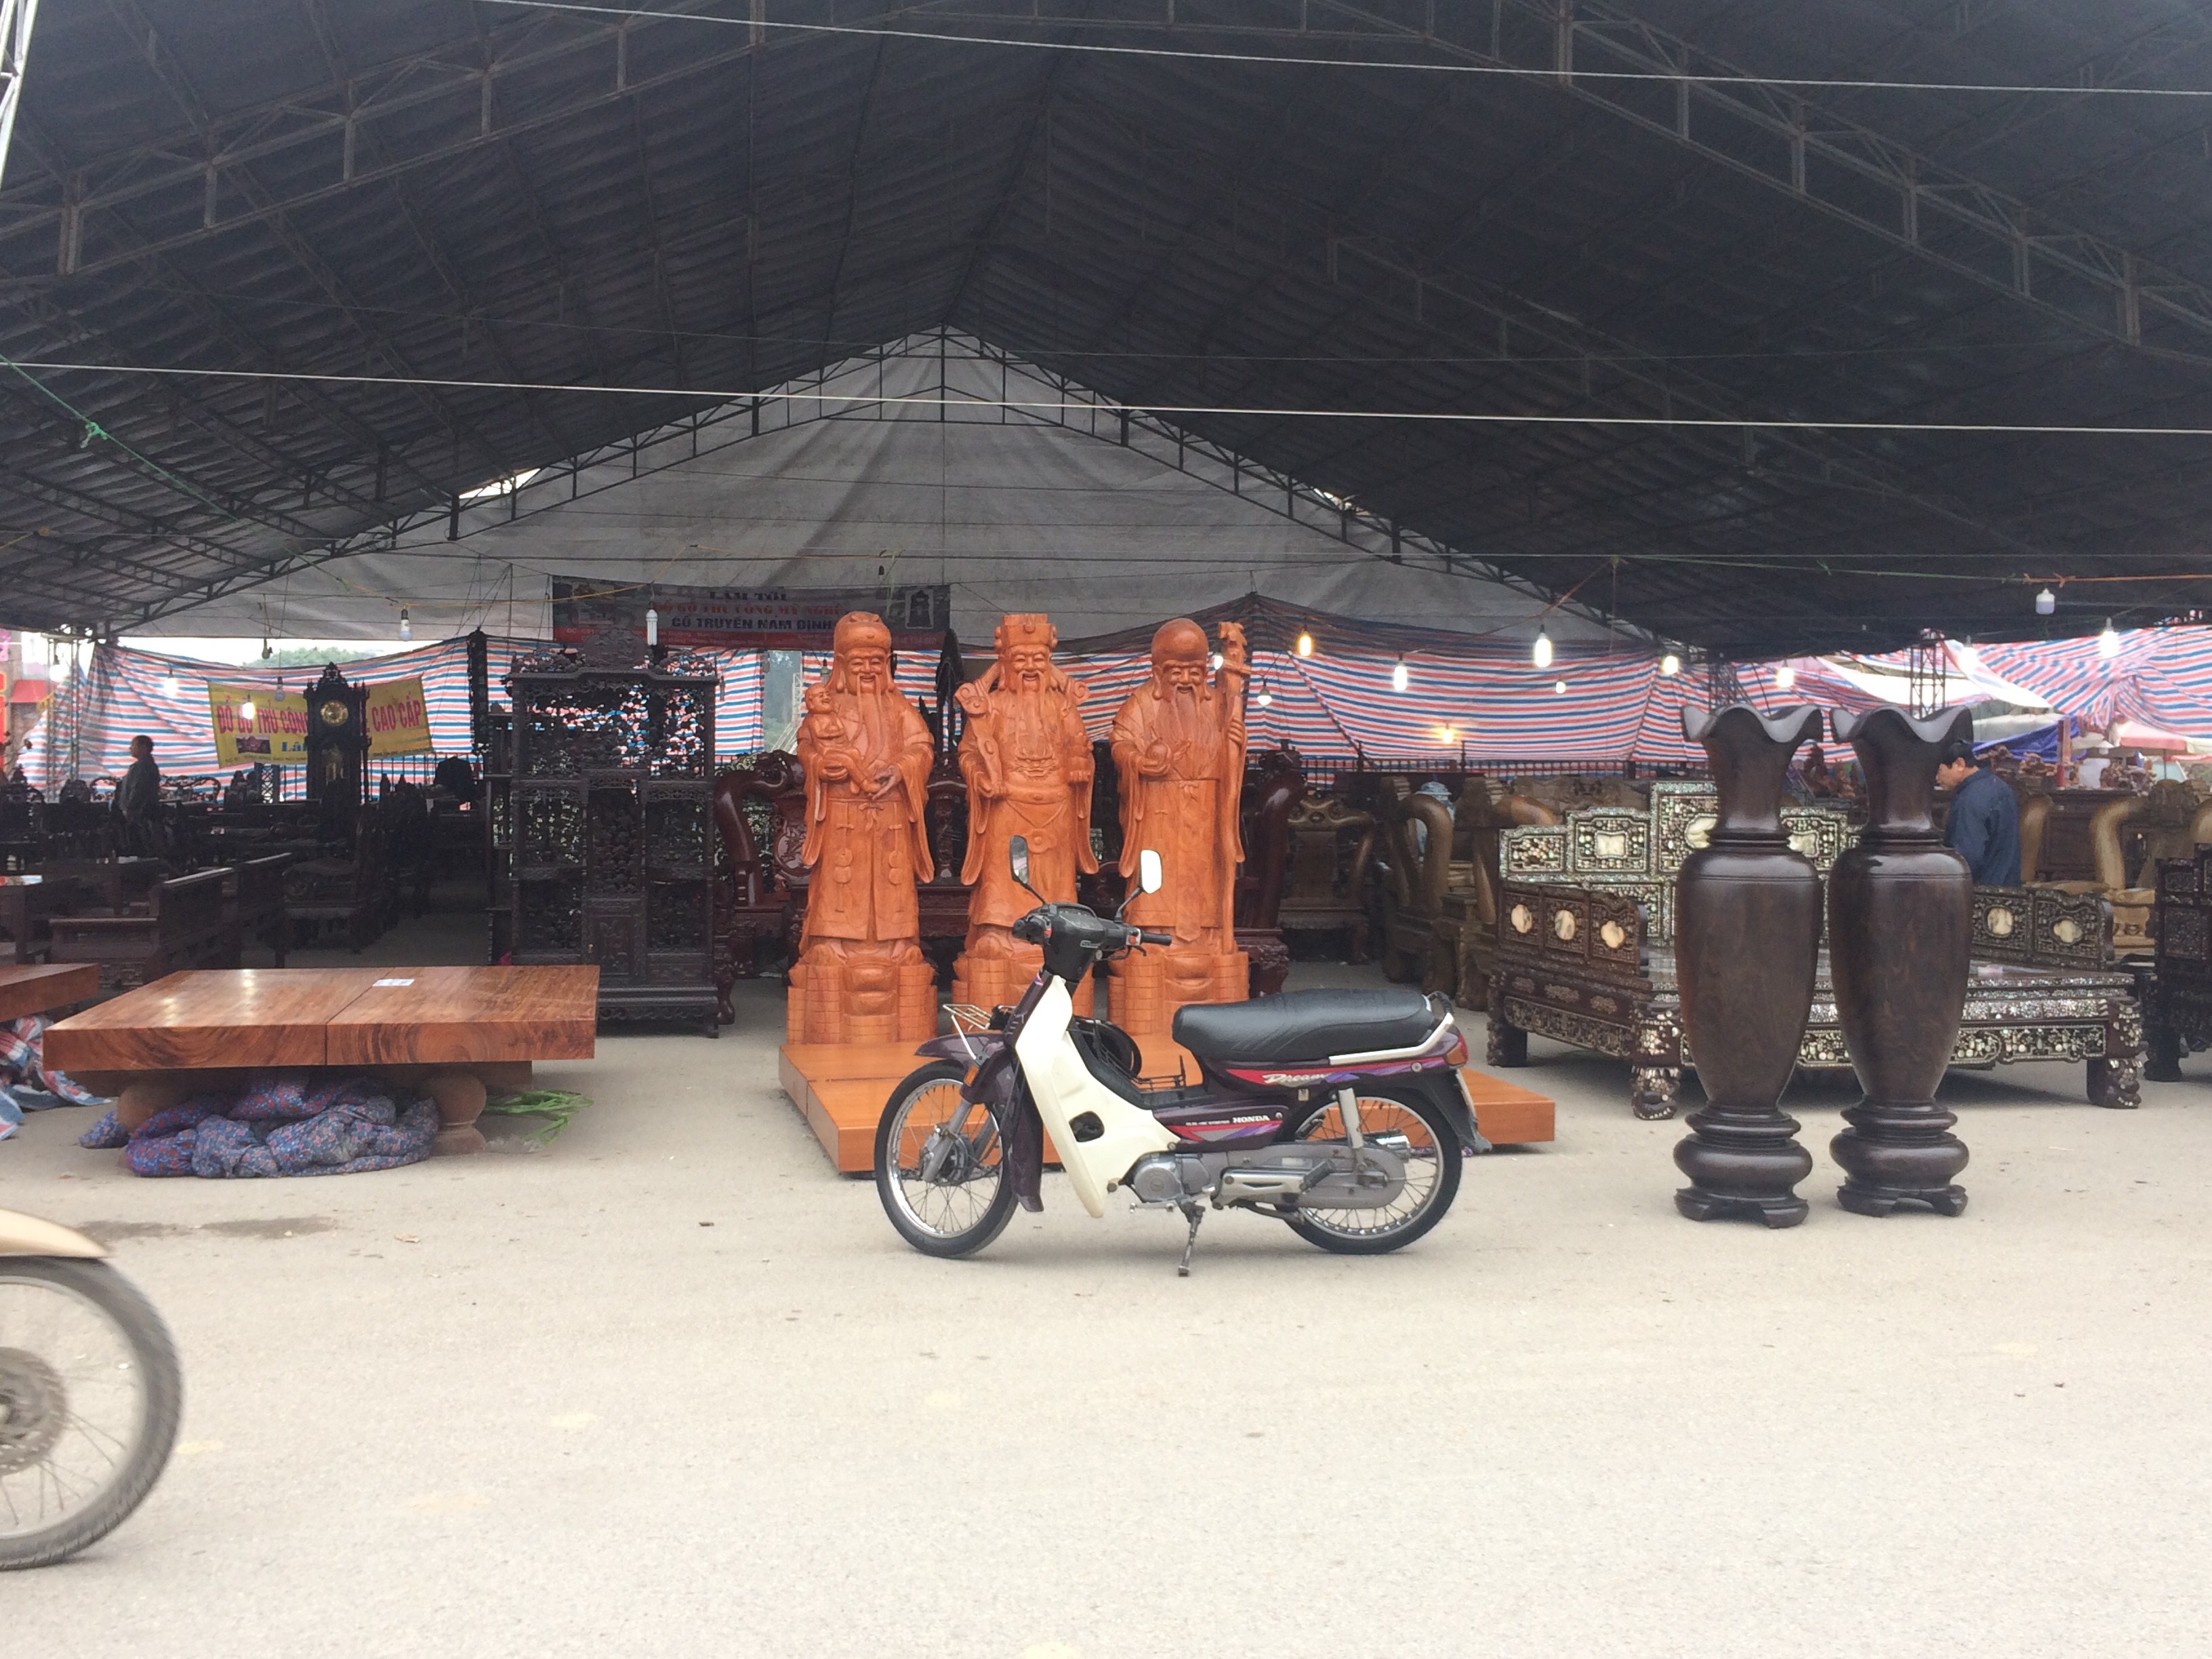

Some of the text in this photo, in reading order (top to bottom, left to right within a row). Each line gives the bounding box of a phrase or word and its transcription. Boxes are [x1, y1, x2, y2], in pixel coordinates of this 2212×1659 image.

[757, 619, 792, 630] NAM
[371, 703, 396, 732] CAO
[398, 691, 422, 729] CẤP
[1232, 1115, 1271, 1124] HONDA
